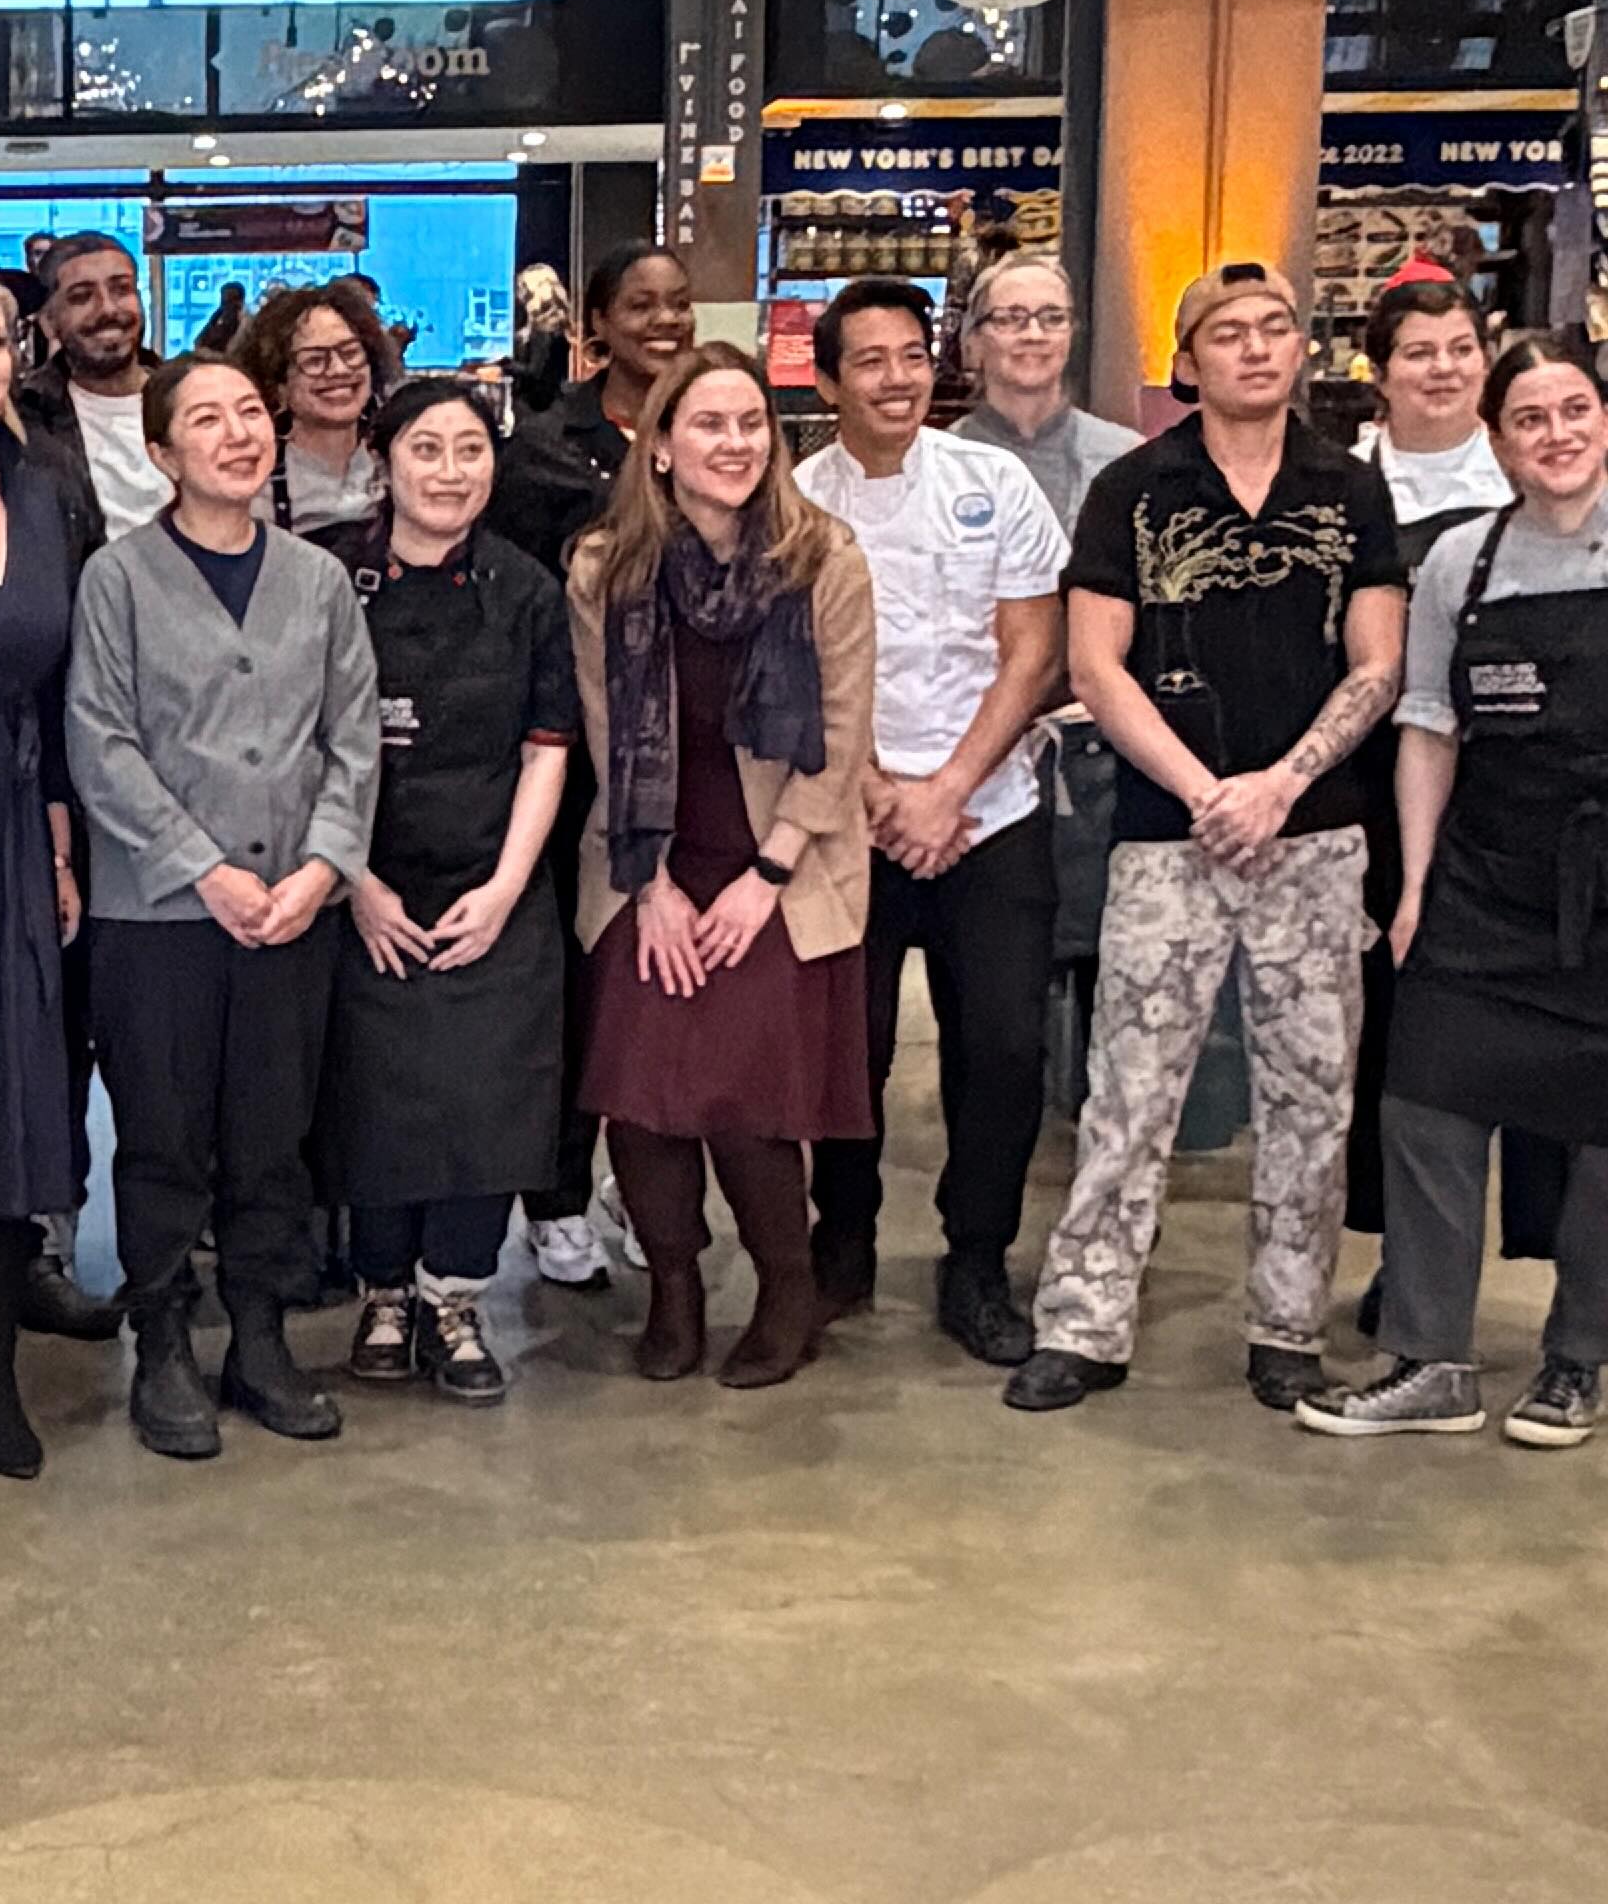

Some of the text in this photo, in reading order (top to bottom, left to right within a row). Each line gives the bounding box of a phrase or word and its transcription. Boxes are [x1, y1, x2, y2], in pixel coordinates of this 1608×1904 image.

[728, 53, 746, 144] FOOD
[794, 147, 1065, 170] NEW YORK'S BEST DA
[1343, 143, 1405, 164] 2022
[1440, 140, 1562, 163] NEW YOR
